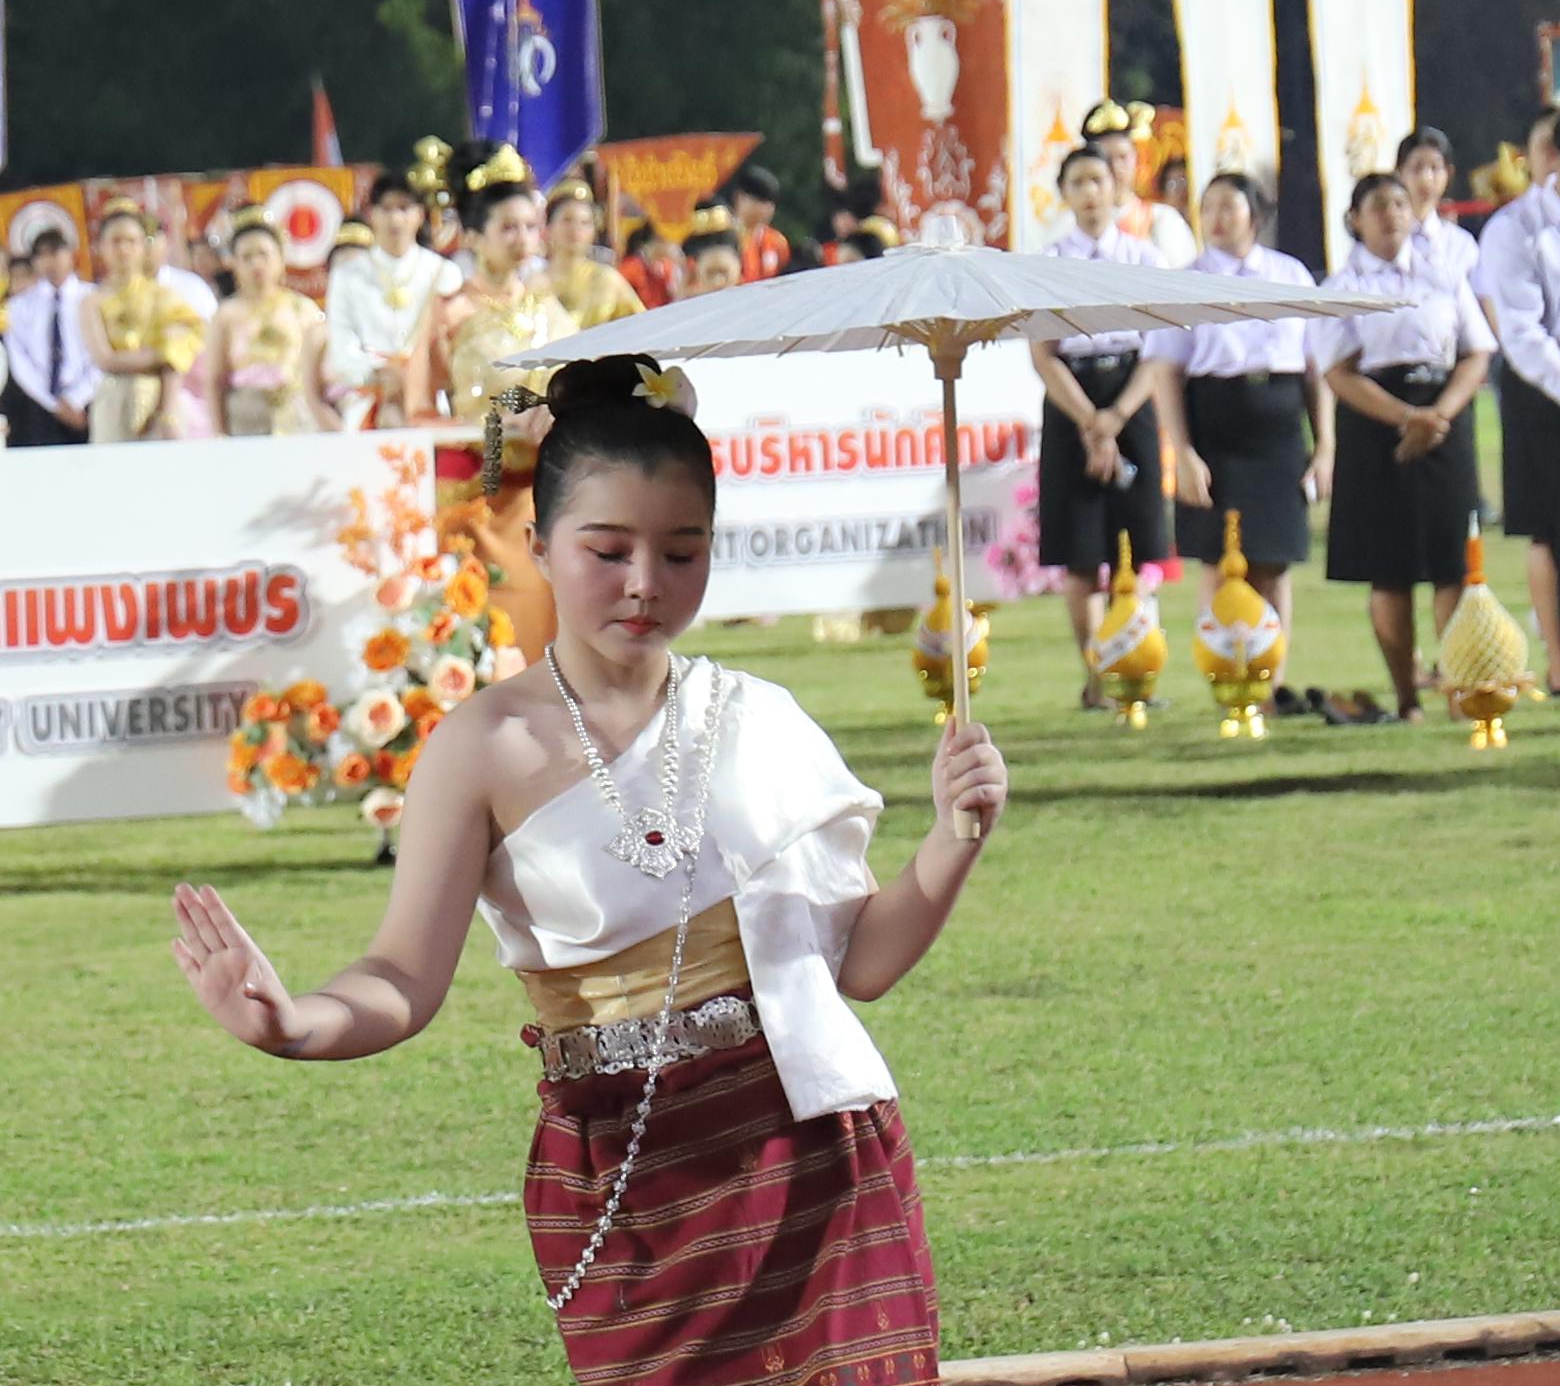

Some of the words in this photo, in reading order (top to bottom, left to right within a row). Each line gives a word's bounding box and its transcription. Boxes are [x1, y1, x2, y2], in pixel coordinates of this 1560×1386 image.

[708, 409, 1028, 478] รบริหารนักศึกษา
[749, 515, 988, 559] ORGANIZATIN
[31, 690, 247, 744] UNIVERSITY
